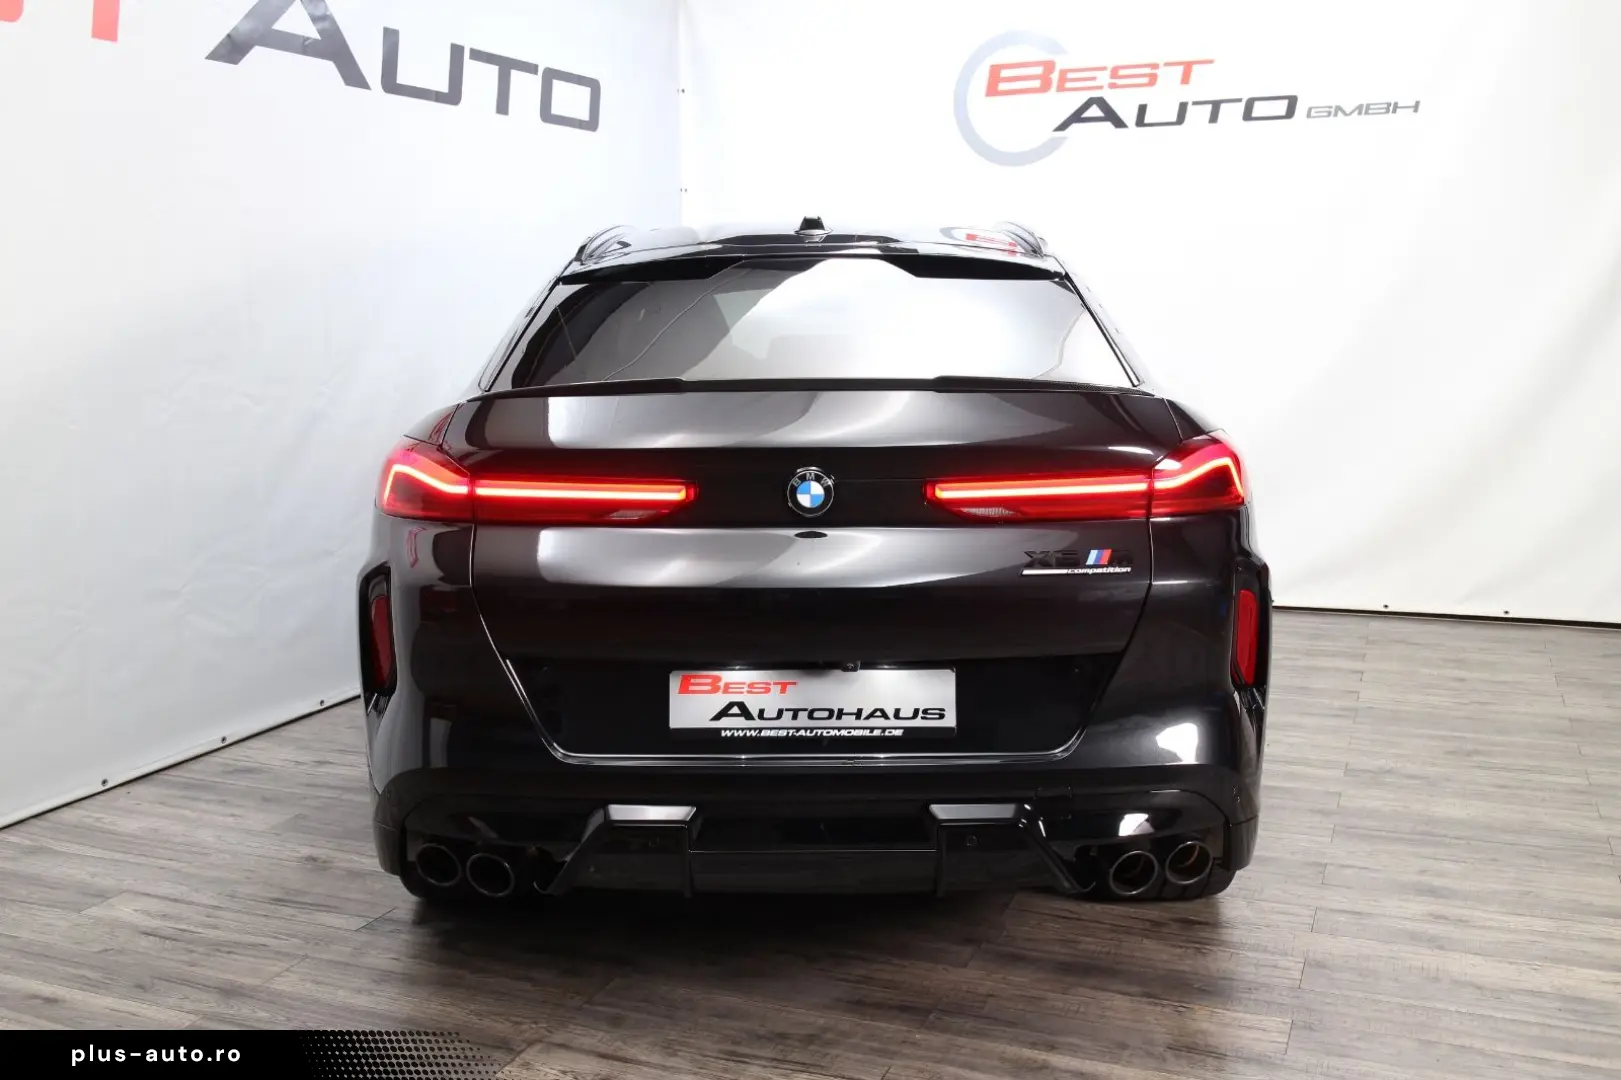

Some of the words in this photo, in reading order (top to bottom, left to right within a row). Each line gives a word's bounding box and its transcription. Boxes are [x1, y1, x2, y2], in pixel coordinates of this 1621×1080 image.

[985, 59, 1216, 97] BEST
[1052, 95, 1299, 132] AUTO
[1305, 100, 1421, 119] GMBH
[677, 673, 799, 695] BEST
[709, 701, 946, 722] AUTOHAUS
[720, 728, 905, 738] WWW.BEST-AUTOMOBILE.DE
